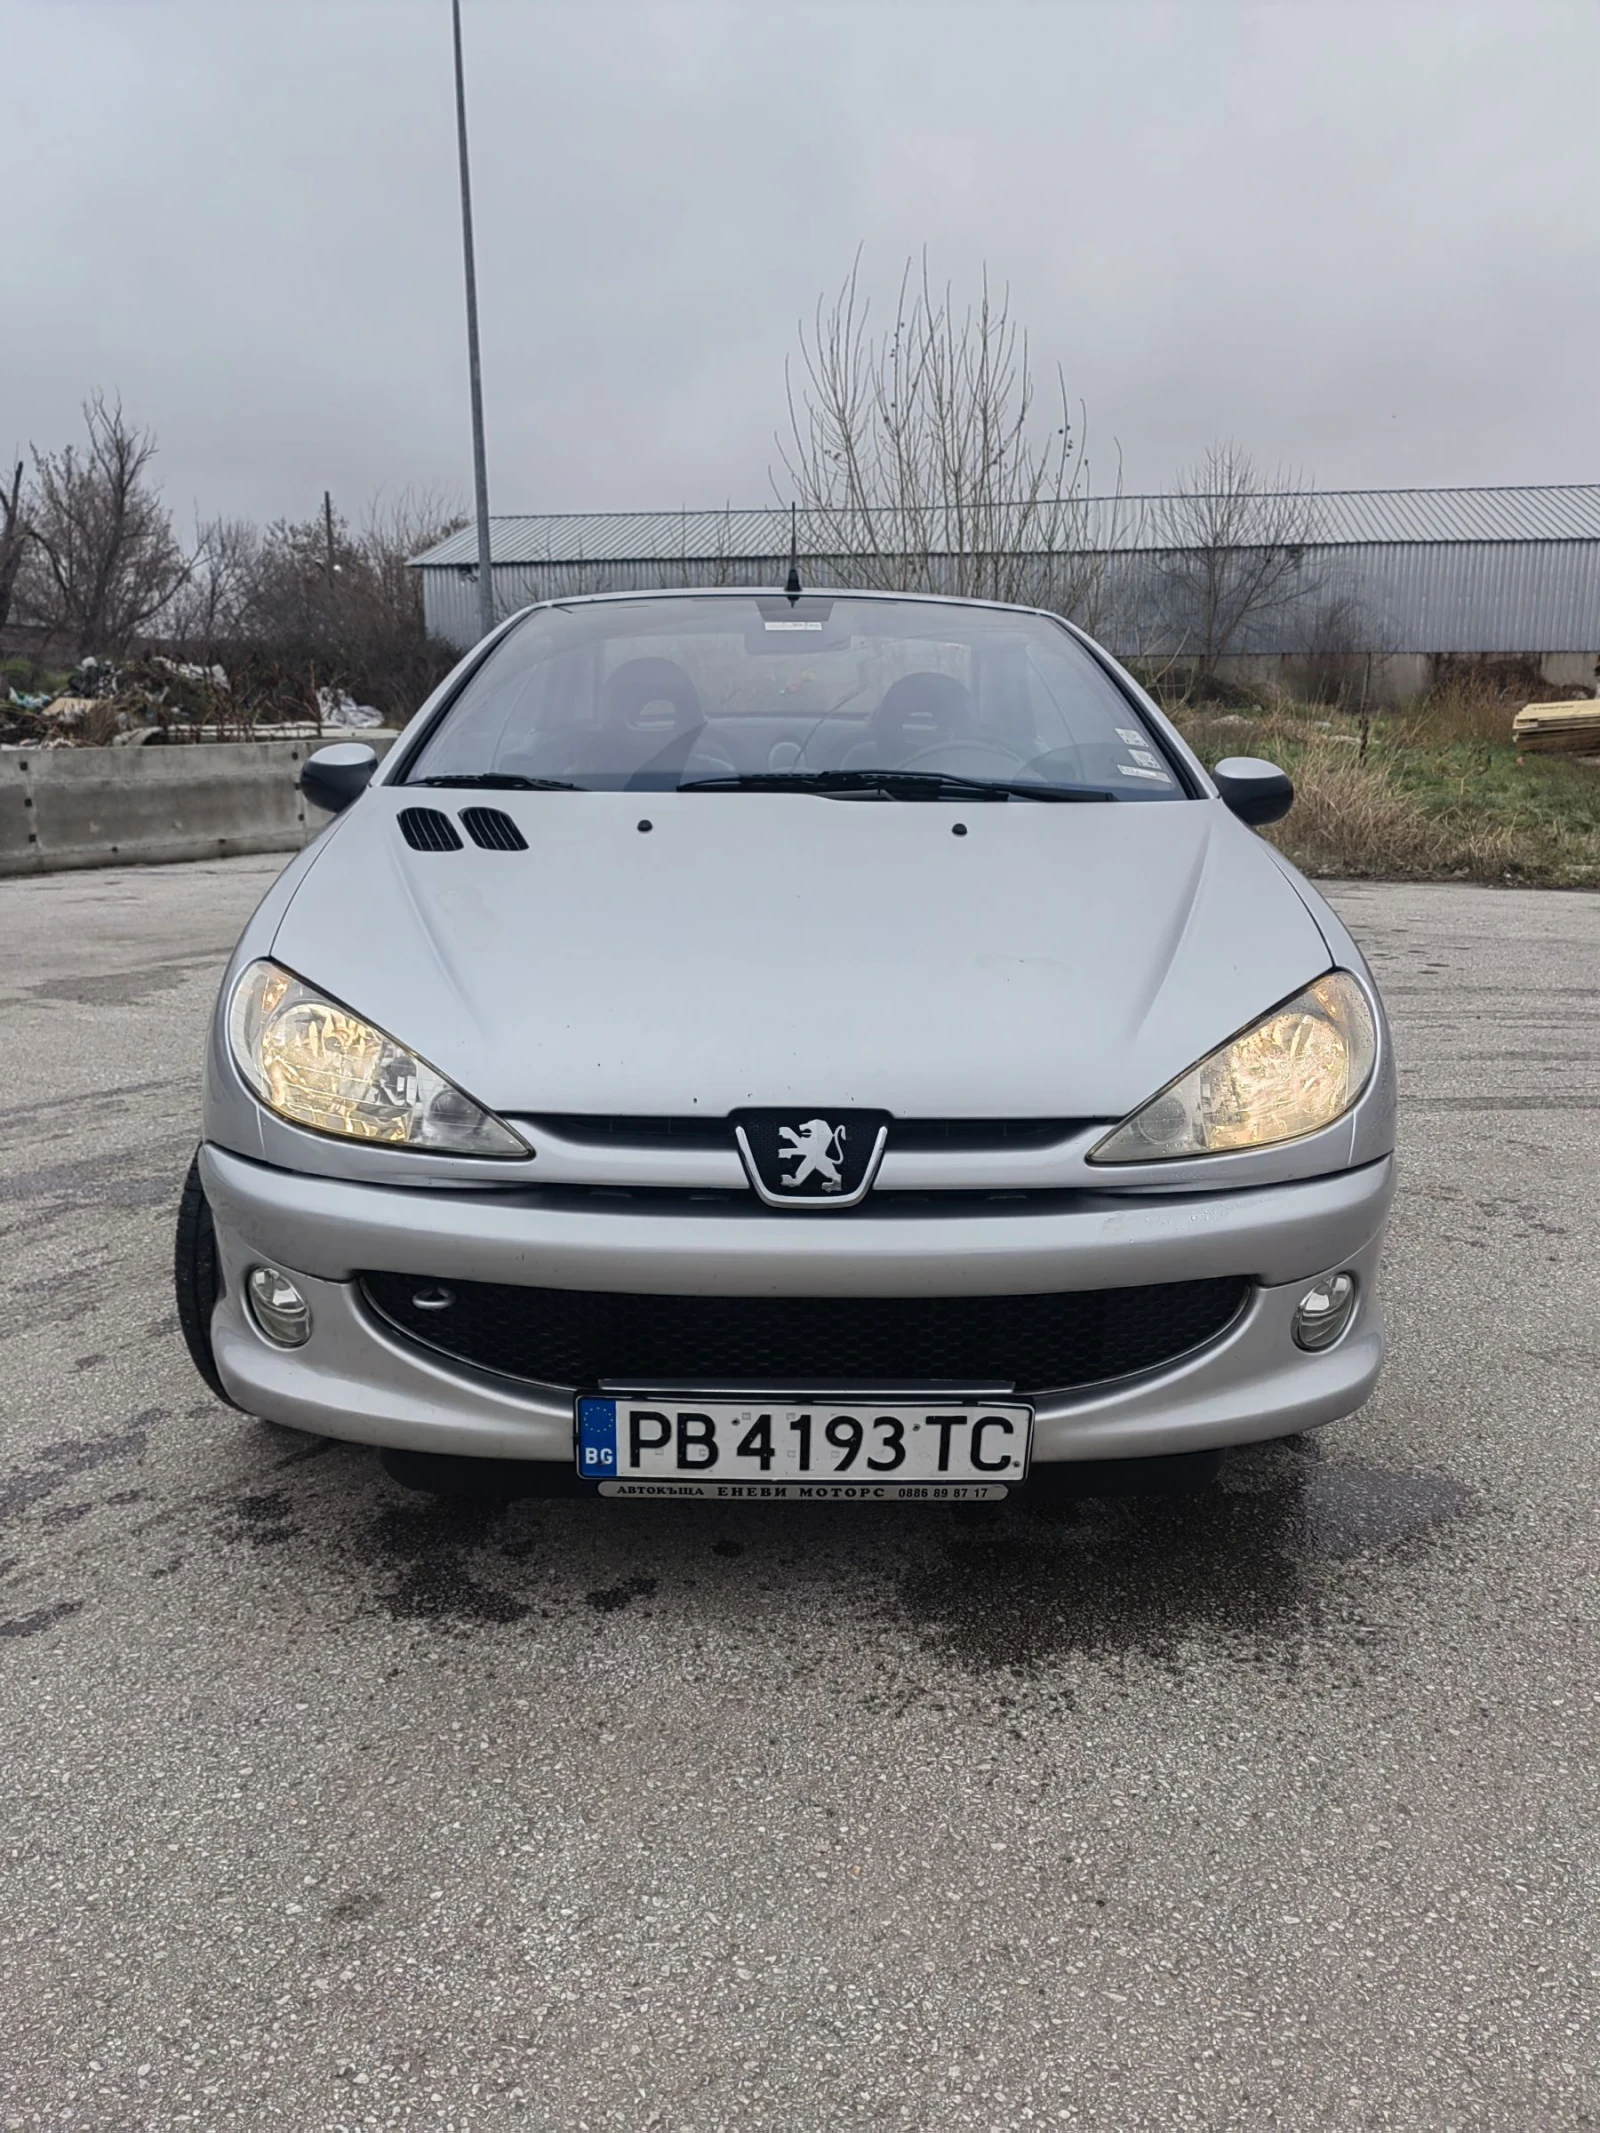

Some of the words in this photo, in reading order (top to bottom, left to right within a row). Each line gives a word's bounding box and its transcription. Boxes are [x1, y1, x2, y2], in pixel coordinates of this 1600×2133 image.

[629, 1410, 719, 1470] PB
[736, 1413, 906, 1472] 4193
[925, 1415, 1014, 1472] TC
[585, 1447, 613, 1464] BG
[617, 1485, 704, 1496] АВТОКЪЩА
[717, 1487, 788, 1497] ЕНЕВИ
[799, 1487, 886, 1497] МОТОРС
[898, 1488, 928, 1498] 0886
[933, 1488, 948, 1498] 89
[953, 1488, 968, 1498] 87
[974, 1488, 988, 1498] 17
